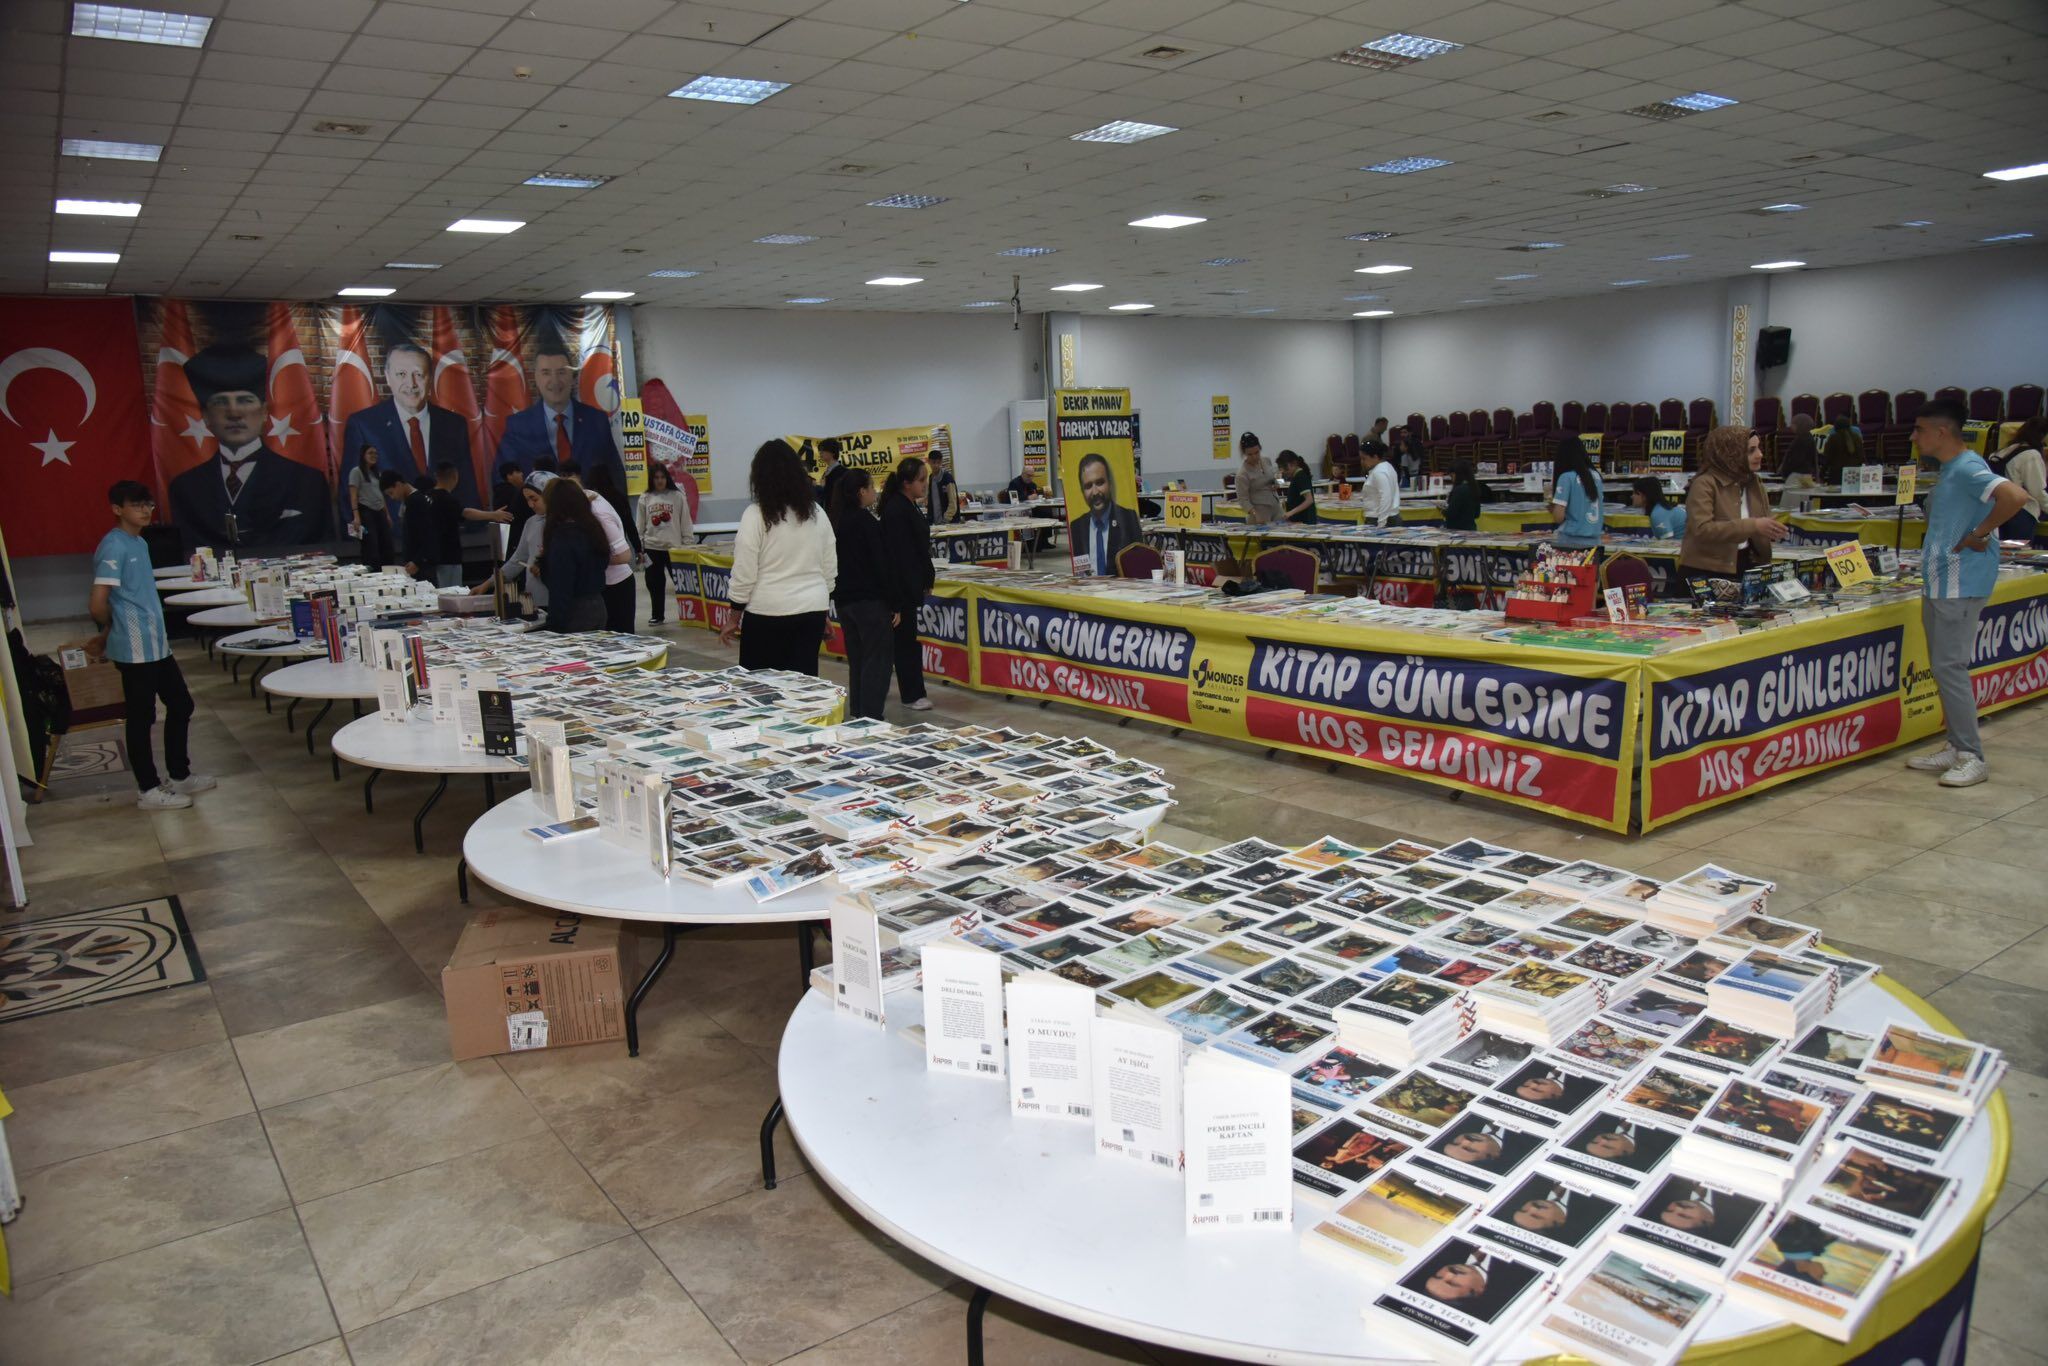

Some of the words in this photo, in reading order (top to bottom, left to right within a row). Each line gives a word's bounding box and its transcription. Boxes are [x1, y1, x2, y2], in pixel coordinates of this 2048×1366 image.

[1063, 396, 1089, 411] BEKİR
[1091, 396, 1122, 410] MANAV
[675, 429, 698, 447] ÖZER
[1024, 429, 1045, 442] KİTAP
[1059, 420, 1099, 440] TARİHÇİ
[1100, 420, 1130, 437] YAZAR
[623, 434, 643, 446] LERİ
[1653, 436, 1682, 450] KİTAP
[1650, 455, 1682, 466] GÜNLERİ
[1170, 505, 1190, 519] 100
[1835, 558, 1856, 576] 150
[983, 608, 1040, 649] KİTAP
[1046, 612, 1188, 672] GÜNLERİNE
[1011, 657, 1050, 693] HOŞ
[1053, 665, 1150, 711] GELDİNİZ
[1207, 671, 1244, 687] MONDES
[1260, 645, 1361, 700] KİTAP
[1368, 656, 1612, 749] GÜNLERİNE
[1660, 678, 1749, 749] KİTAP
[1757, 641, 1896, 723] GÜNLERİNE
[1297, 711, 1369, 757] HOŞ
[1379, 726, 1543, 797] GELDİNİZ
[1698, 746, 1750, 797] HOŞ
[1753, 714, 1865, 777] GELDİNİZ
[1037, 1029, 1076, 1039] MUYDU?
[1118, 1057, 1128, 1065] AY
[1207, 1124, 1236, 1133] PEMBE
[1219, 1131, 1253, 1140] KAFTAN
[1398, 1289, 1436, 1311] ELMA
[1438, 1307, 1476, 1328] KIZIL
